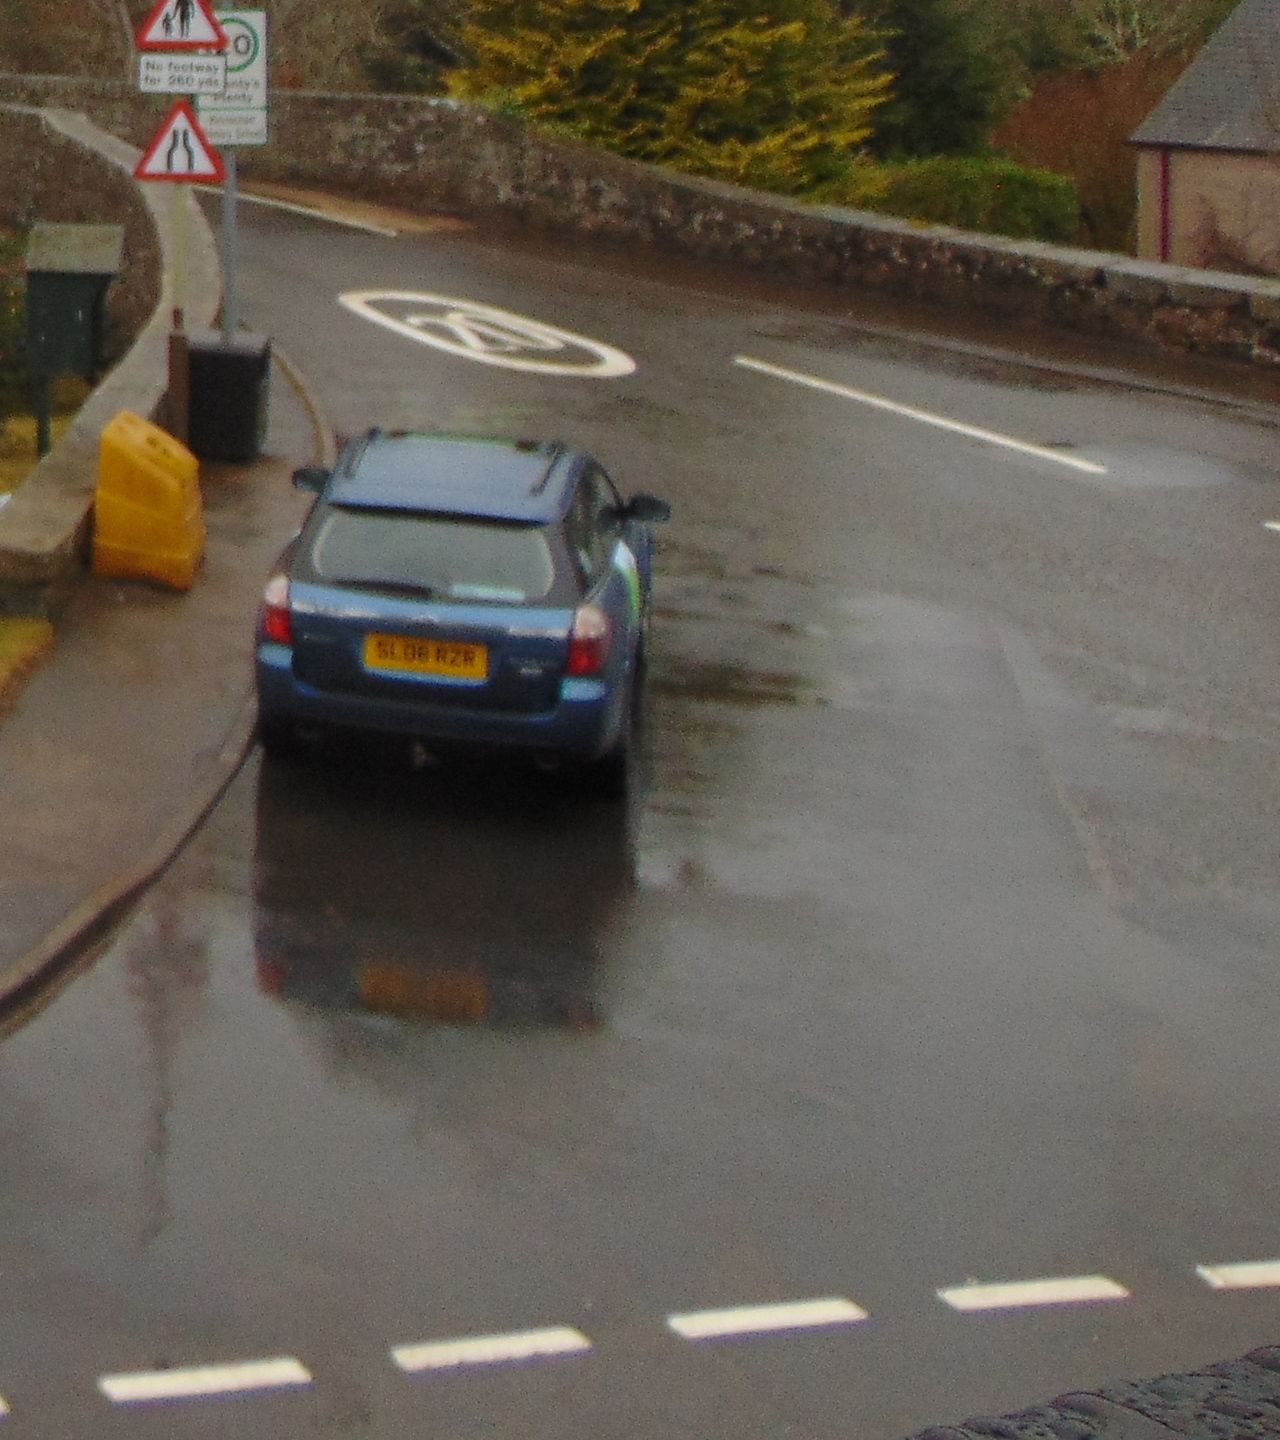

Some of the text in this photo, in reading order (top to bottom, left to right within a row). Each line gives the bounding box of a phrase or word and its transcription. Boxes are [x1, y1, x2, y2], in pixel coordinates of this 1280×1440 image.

[146, 61, 219, 75] No footway
[145, 74, 161, 85] for
[197, 76, 219, 88] yds
[406, 312, 564, 351] 20
